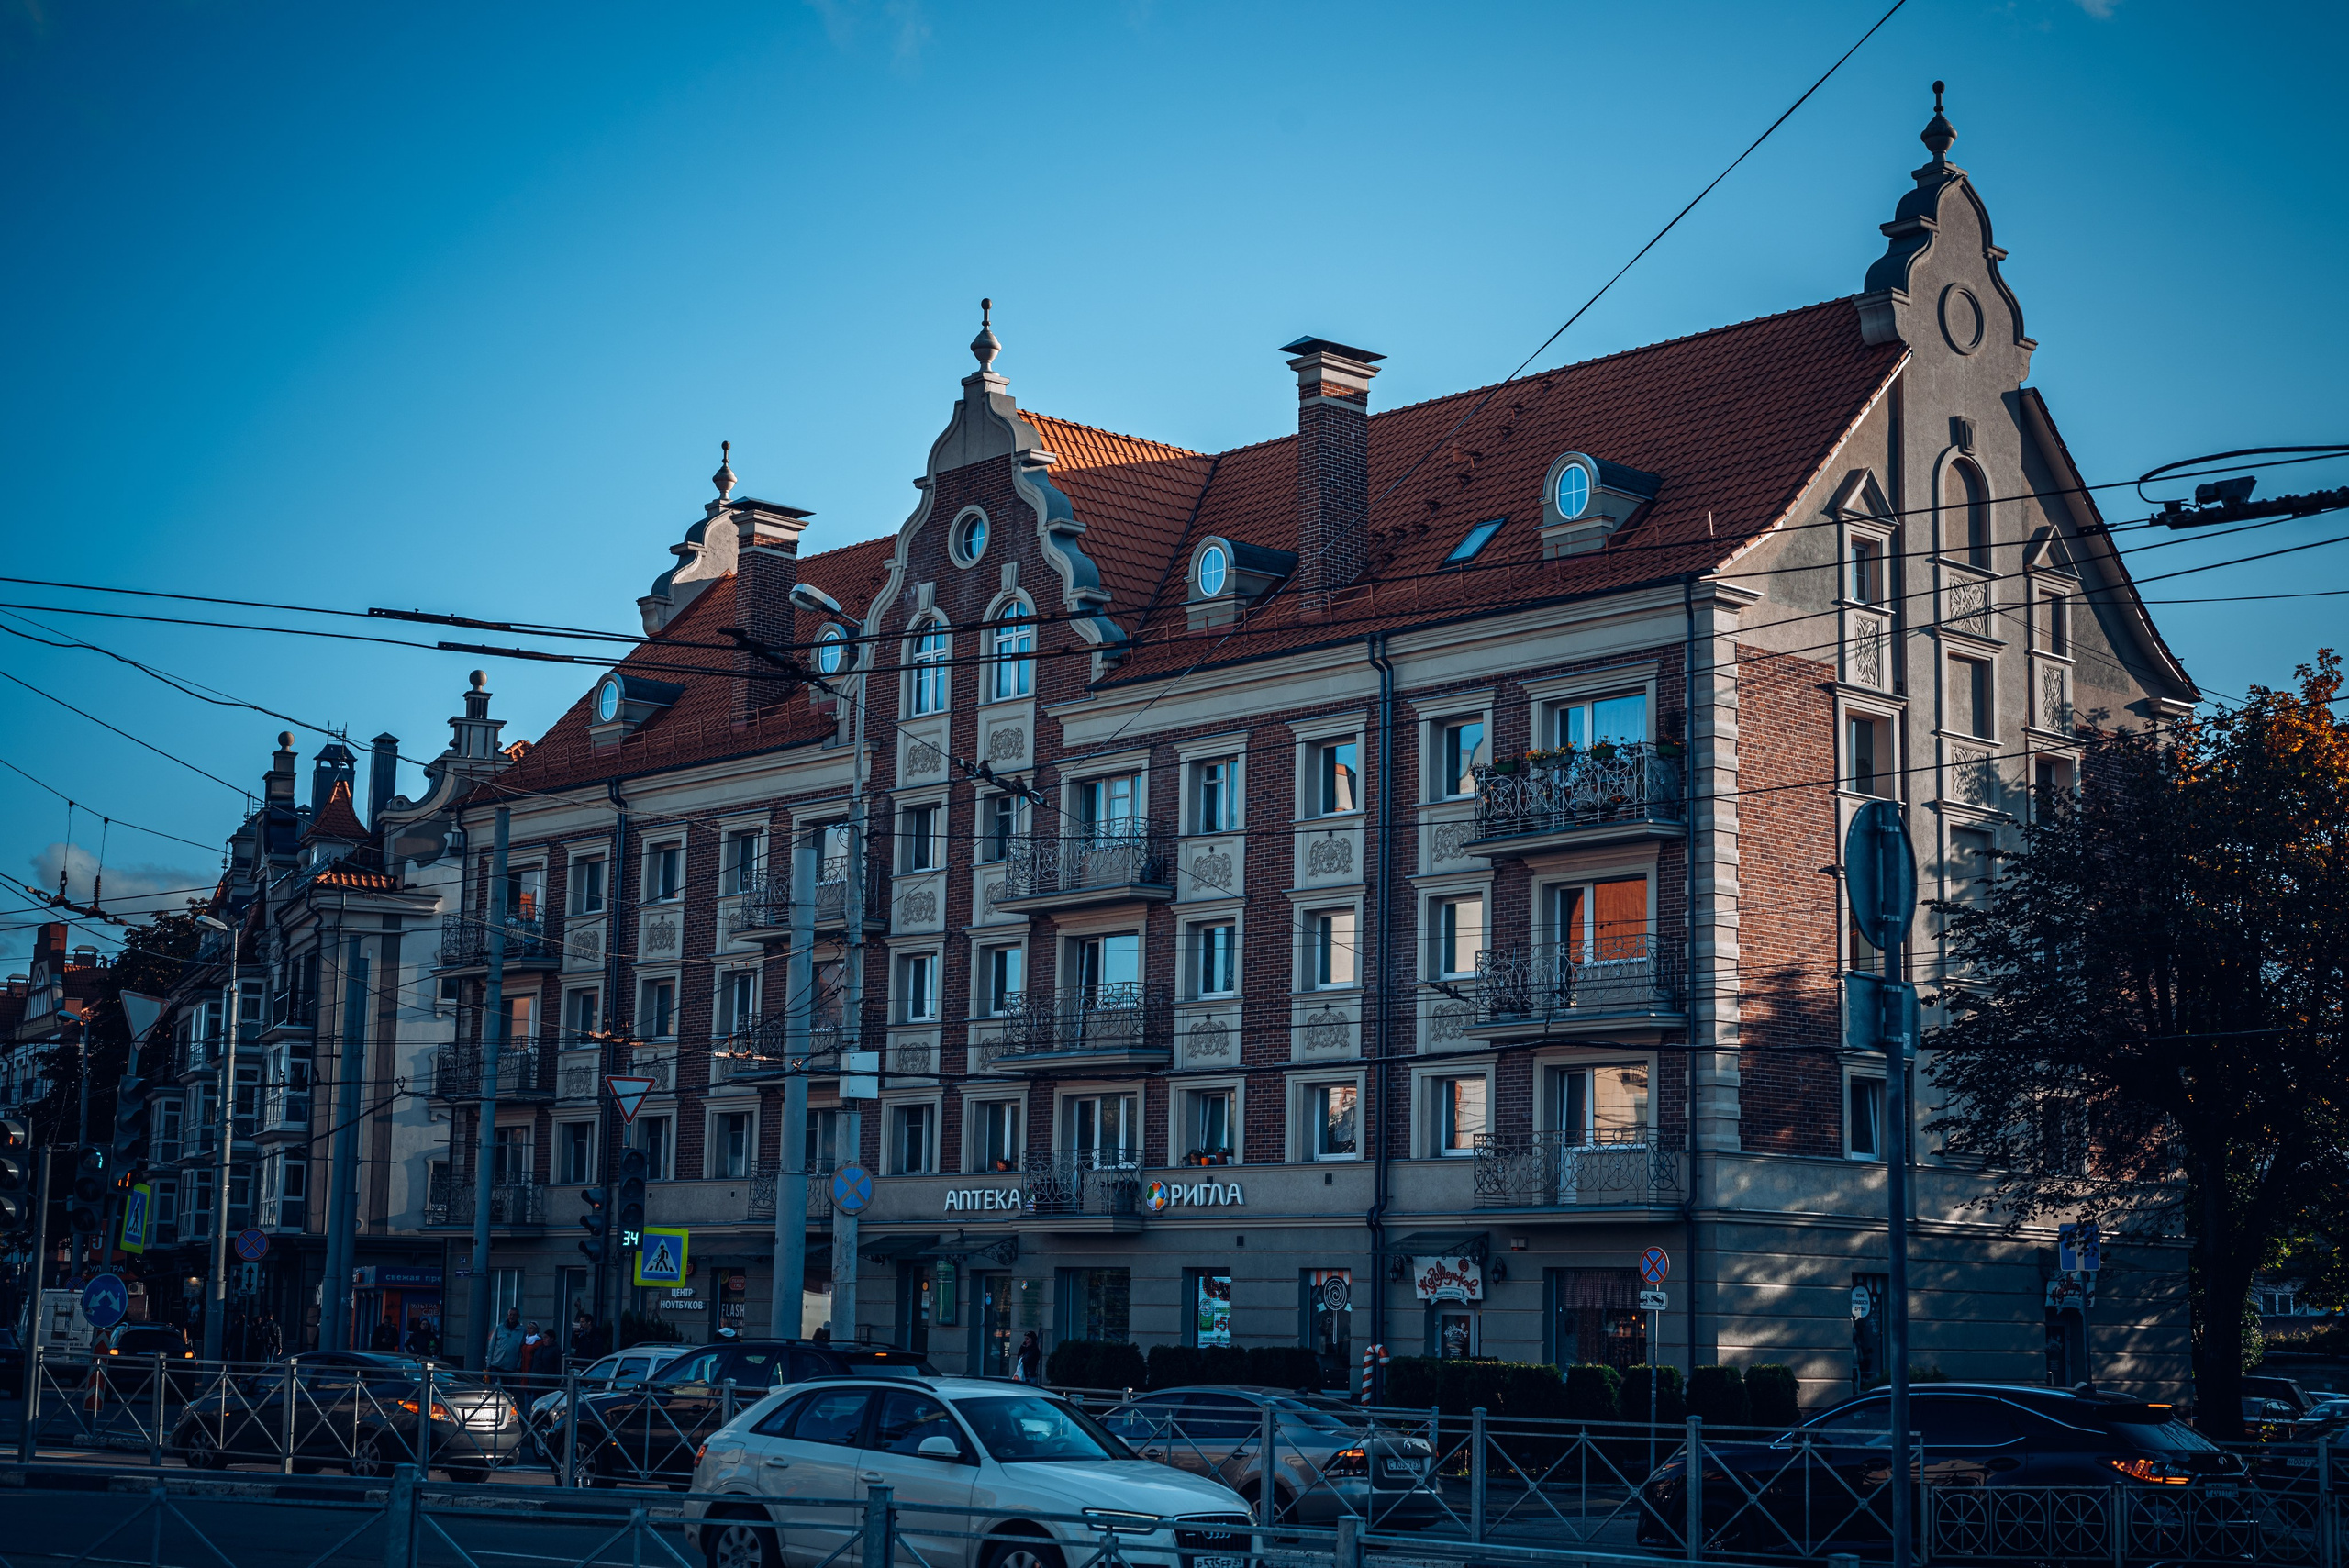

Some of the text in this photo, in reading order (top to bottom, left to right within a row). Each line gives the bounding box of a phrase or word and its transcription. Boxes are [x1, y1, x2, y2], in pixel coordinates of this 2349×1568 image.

[944, 1189, 1022, 1211] АПТЕКА
[1170, 1183, 1245, 1207] РИГЛА
[622, 1230, 640, 1246] 34
[89, 1264, 125, 1273] УЛРА
[671, 1288, 694, 1298] ЦЕНТР
[660, 1300, 704, 1310] НОУТБУКОВ
[721, 1304, 745, 1317] FLASH
